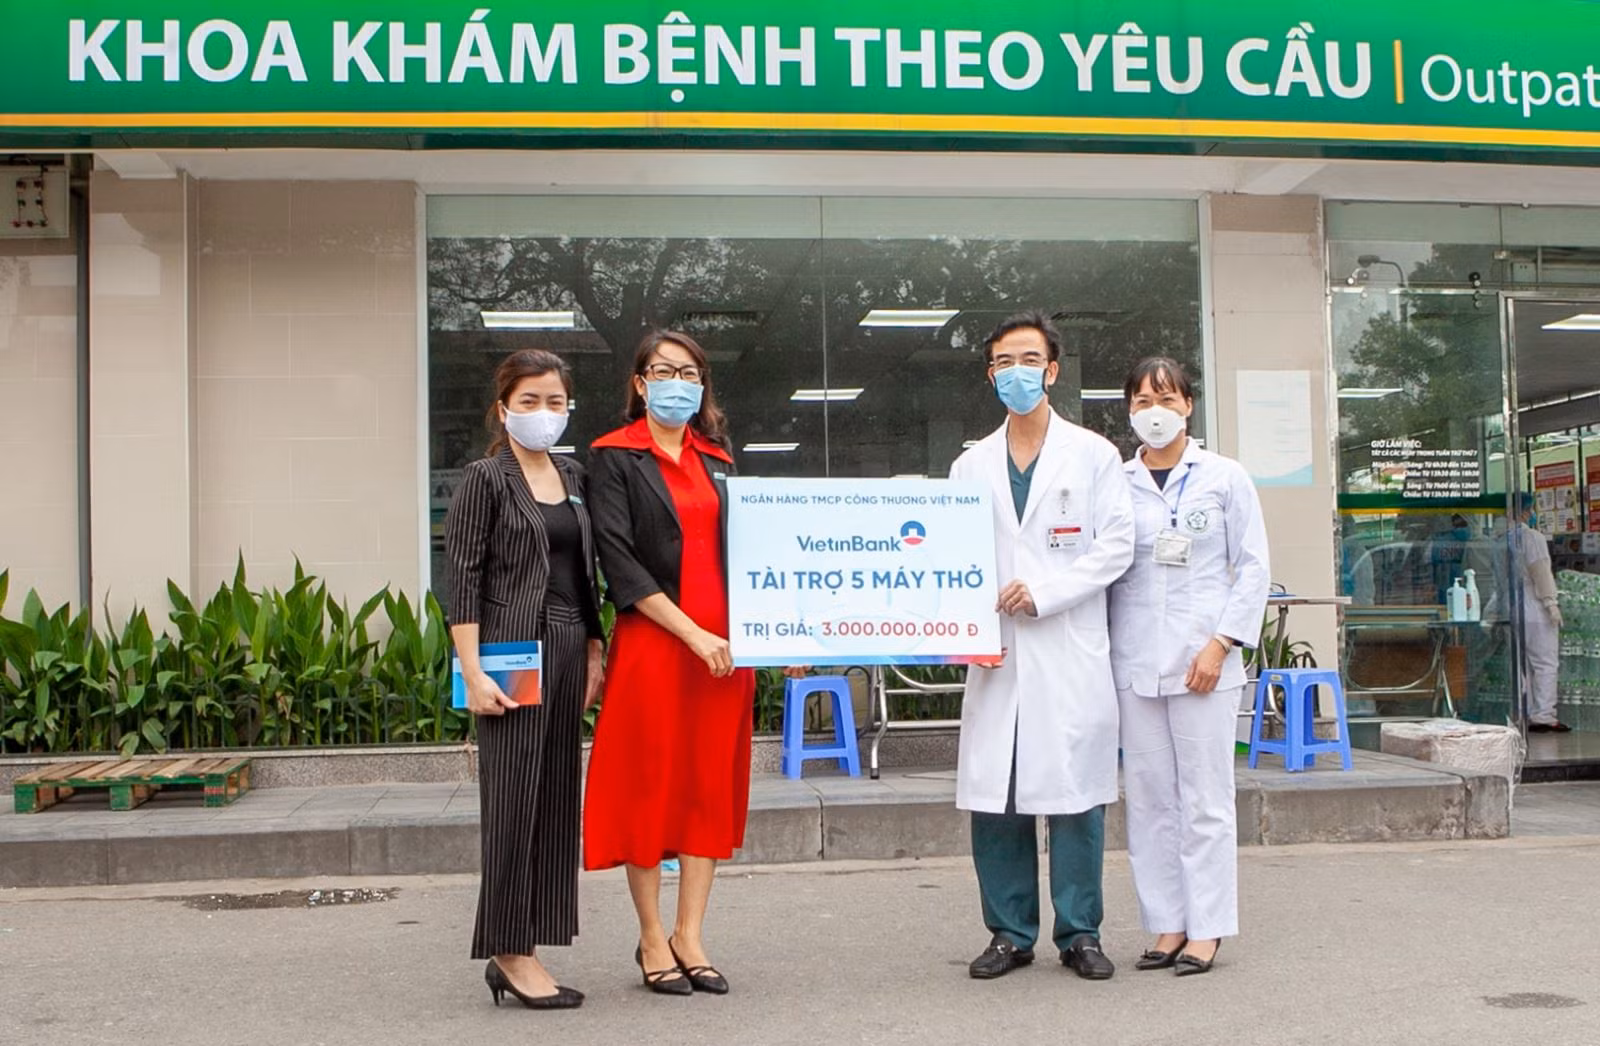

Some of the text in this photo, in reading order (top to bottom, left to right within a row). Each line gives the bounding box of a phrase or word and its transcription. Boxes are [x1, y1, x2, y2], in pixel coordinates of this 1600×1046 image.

[69, 8, 1372, 103] KHOA KHÁM BỆNH THEO YÊU CẦU
[1420, 54, 1600, 118] Outpat
[741, 493, 980, 507] NGÂN HÀNG TMCP CÔNG THƯƠNG VIỆT NAM
[797, 535, 902, 552] VietinBank
[747, 564, 984, 595] TÀI TRỢ 5 MÁY THỞ
[743, 618, 979, 640] TRỊ GIÁ: 3.000.000.000 Đ
